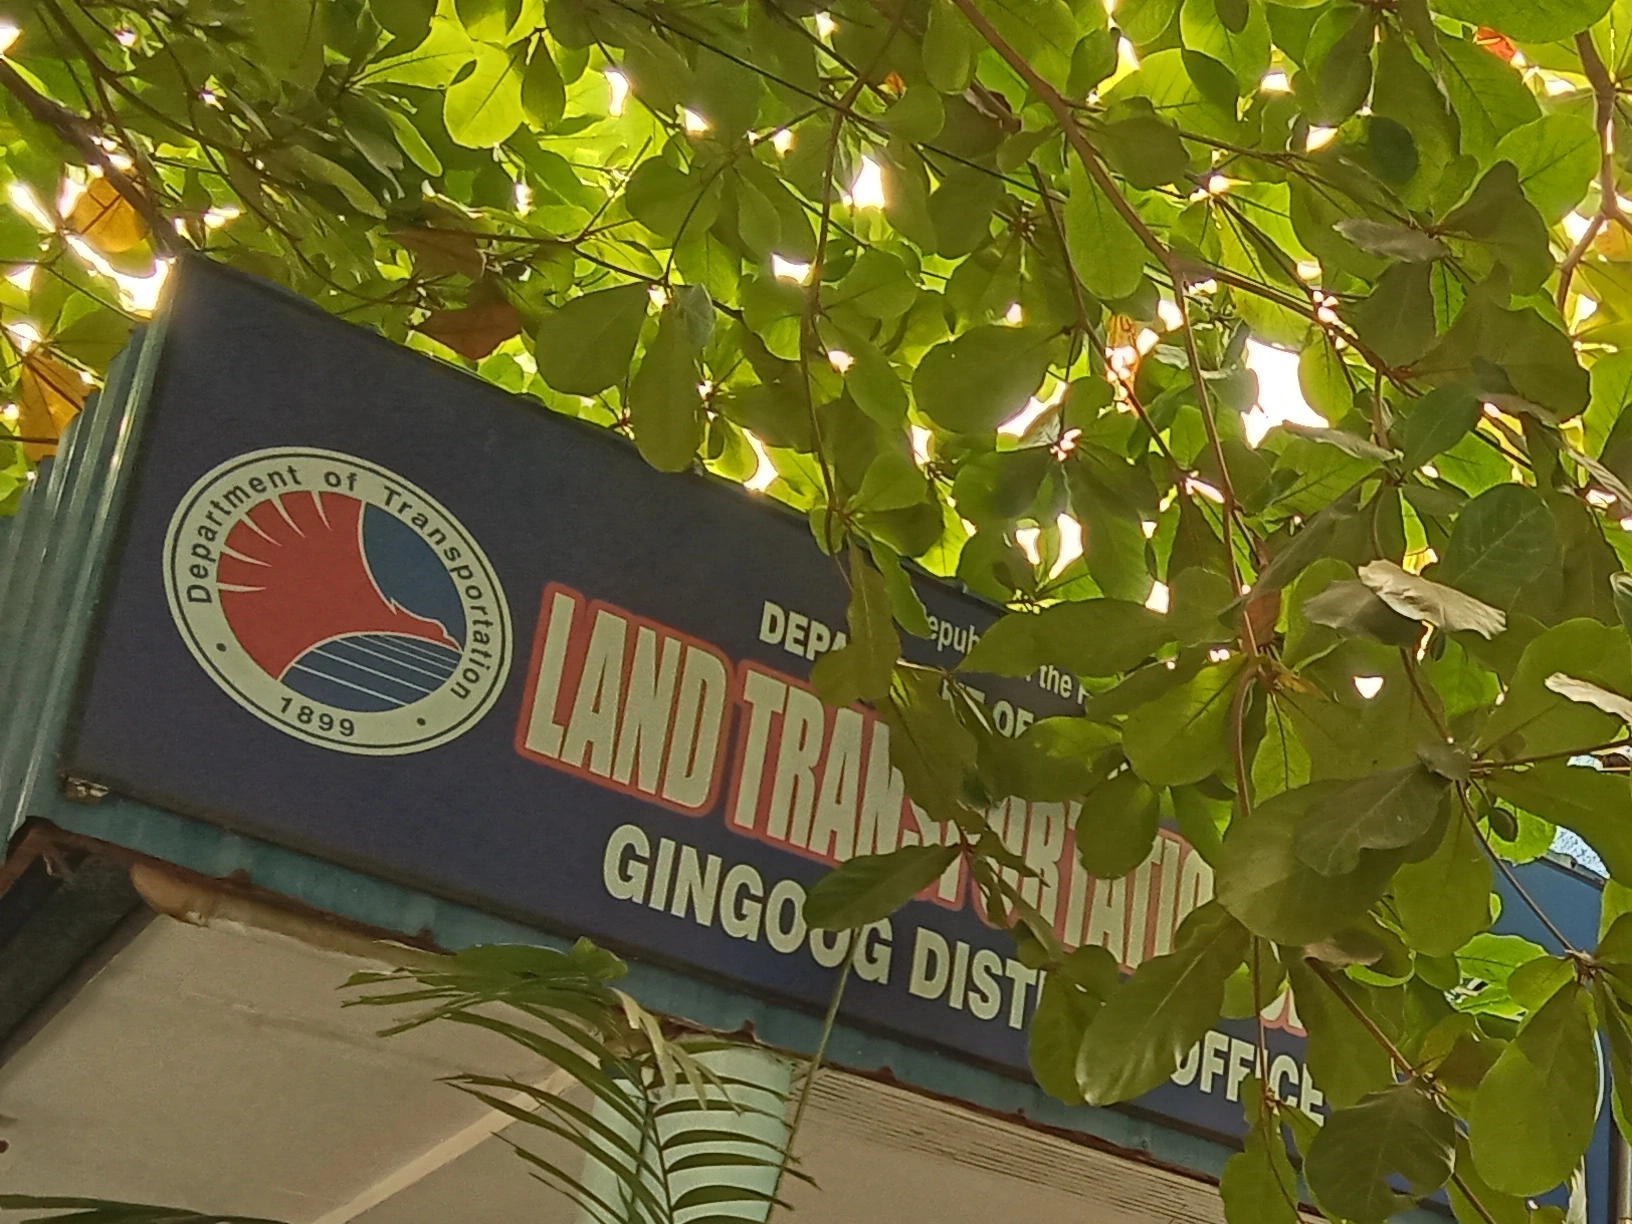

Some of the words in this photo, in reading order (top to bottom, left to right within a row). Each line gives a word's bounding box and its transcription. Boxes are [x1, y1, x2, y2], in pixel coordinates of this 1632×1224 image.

[186, 463, 303, 605] Department
[323, 470, 358, 493] of
[381, 485, 494, 702] Transportation
[278, 695, 356, 738] 1899
[523, 590, 728, 809] LAND
[1039, 664, 1074, 699] the
[603, 823, 894, 986] GINGOOG
